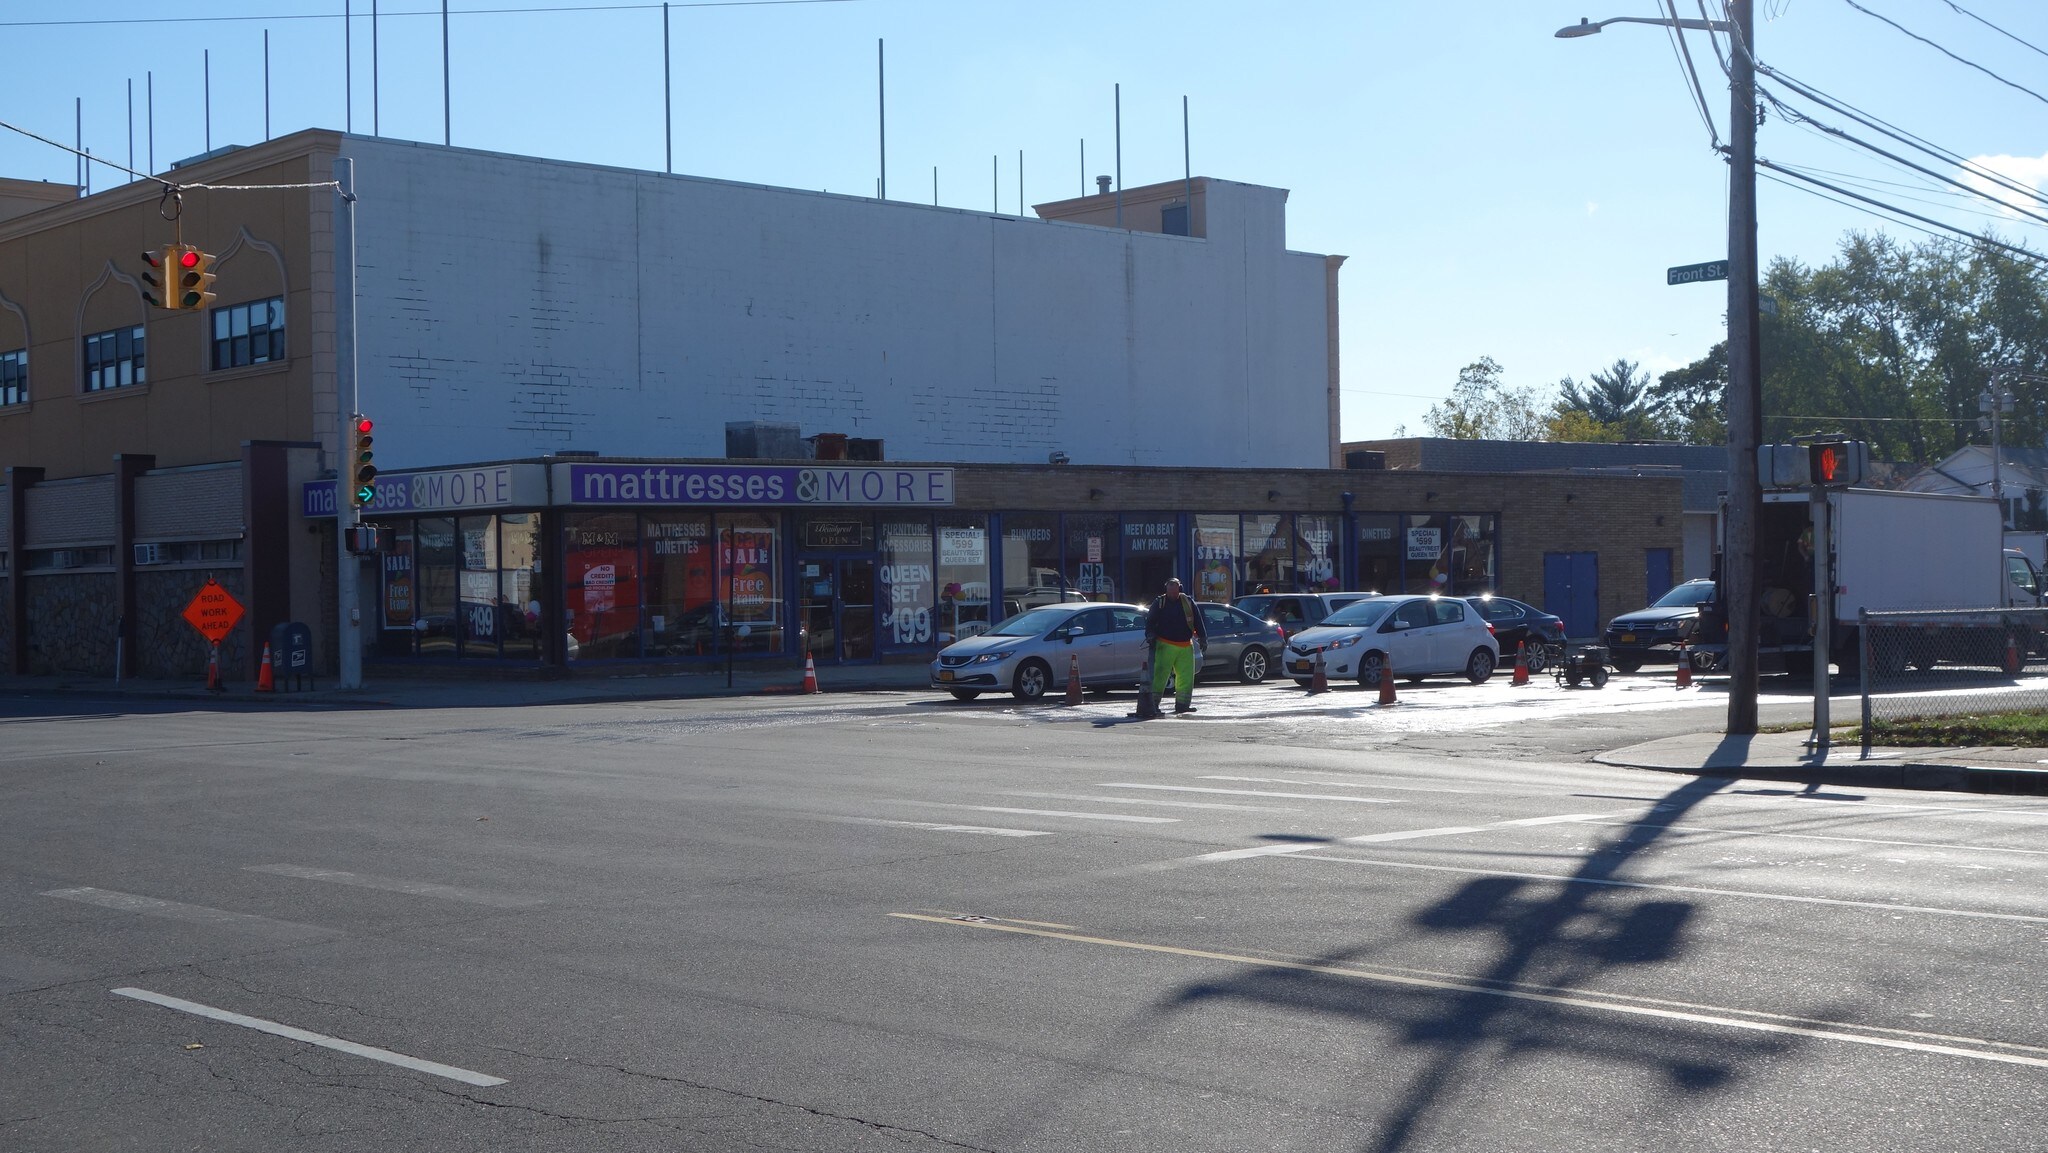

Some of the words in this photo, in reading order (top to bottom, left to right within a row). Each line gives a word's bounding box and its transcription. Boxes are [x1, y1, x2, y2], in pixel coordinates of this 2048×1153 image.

[1669, 267, 1704, 284] Front
[1707, 264, 1725, 278] St.
[583, 467, 784, 499] mattresses
[647, 523, 706, 537] MATTRESSES
[882, 523, 928, 536] FURNITURE
[1010, 528, 1051, 541] BUNKBEDS
[1124, 523, 1144, 536] MEET
[1145, 523, 1156, 536] OR
[1157, 523, 1175, 536] BEAT
[1362, 528, 1392, 540] DINETTES
[1250, 537, 1286, 549] FURNITURE
[1304, 530, 1333, 543] QUEEN
[1415, 537, 1433, 545] $599
[655, 540, 699, 555] DINETTES
[878, 540, 932, 552] ACCESSORIES
[951, 540, 974, 549] $599
[1131, 538, 1147, 551] ANY
[1148, 538, 1169, 551] PRICE
[1310, 542, 1329, 555] SET
[724, 548, 768, 564] SALE
[1197, 545, 1230, 560] SALE
[386, 555, 411, 571] SALE
[880, 565, 930, 585] QUEEN
[732, 577, 764, 592] Free
[1081, 578, 1102, 586] CREIT
[389, 584, 409, 597] Free
[891, 584, 921, 602] SET
[201, 594, 225, 603] ROAD
[200, 607, 228, 617] WORK
[201, 620, 229, 630] AHEAD
[469, 606, 494, 637] $199
[881, 606, 932, 644] $199
